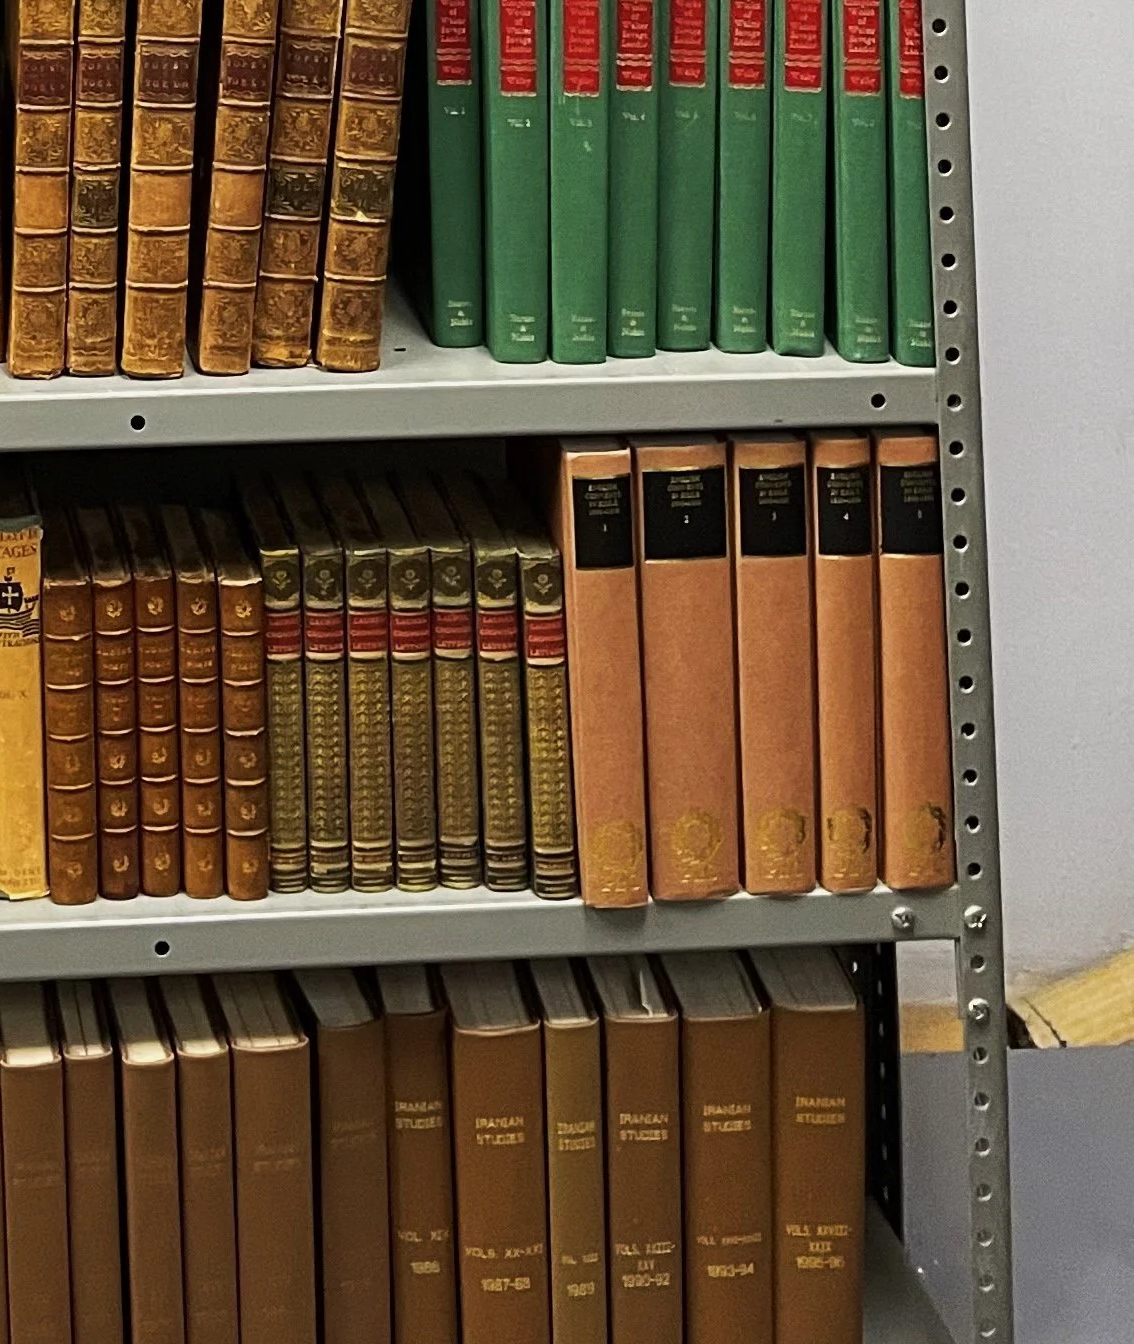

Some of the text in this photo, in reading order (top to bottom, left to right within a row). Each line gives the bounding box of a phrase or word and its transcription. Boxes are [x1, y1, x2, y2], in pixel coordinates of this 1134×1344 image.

[395, 1101, 443, 1112] IRANIAN
[796, 1097, 846, 1108] IRANIAN
[703, 1104, 751, 1116] IRANIAN
[395, 1116, 443, 1130] STUDIES
[475, 1117, 524, 1129] IRANIAN
[620, 1113, 668, 1125] IRANIAN
[796, 1113, 846, 1125] STUDIES
[703, 1120, 752, 1133] STUDIES
[477, 1132, 525, 1145] STUDIES
[620, 1129, 668, 1141] STUDIES
